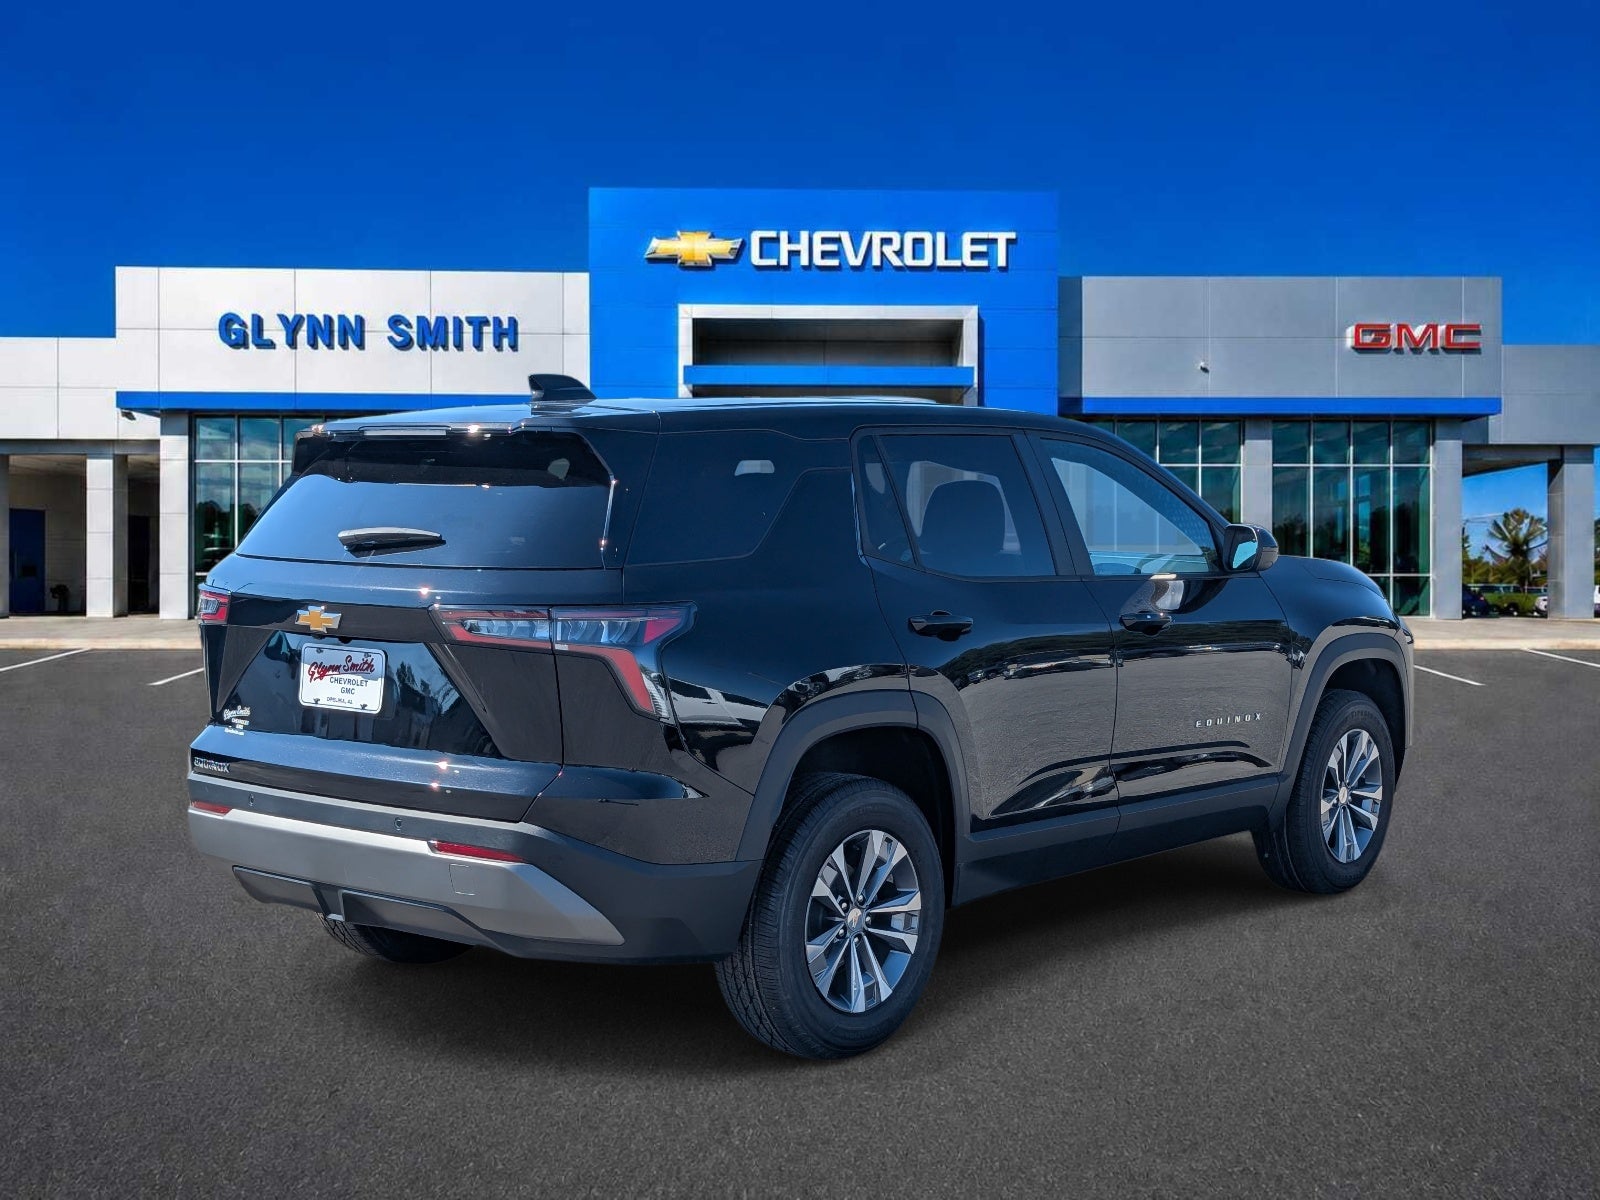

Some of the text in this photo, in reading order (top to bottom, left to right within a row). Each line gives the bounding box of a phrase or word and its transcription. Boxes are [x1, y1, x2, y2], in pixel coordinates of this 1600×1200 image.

[750, 230, 1017, 268] CHEVROLET
[218, 312, 519, 352] GLYNN SMITH
[1349, 323, 1482, 353] GMC
[307, 654, 375, 683] Glynn Smith
[329, 676, 368, 688] CHEVROLET
[340, 686, 355, 695] GMC
[1195, 712, 1261, 728] EQUINOX
